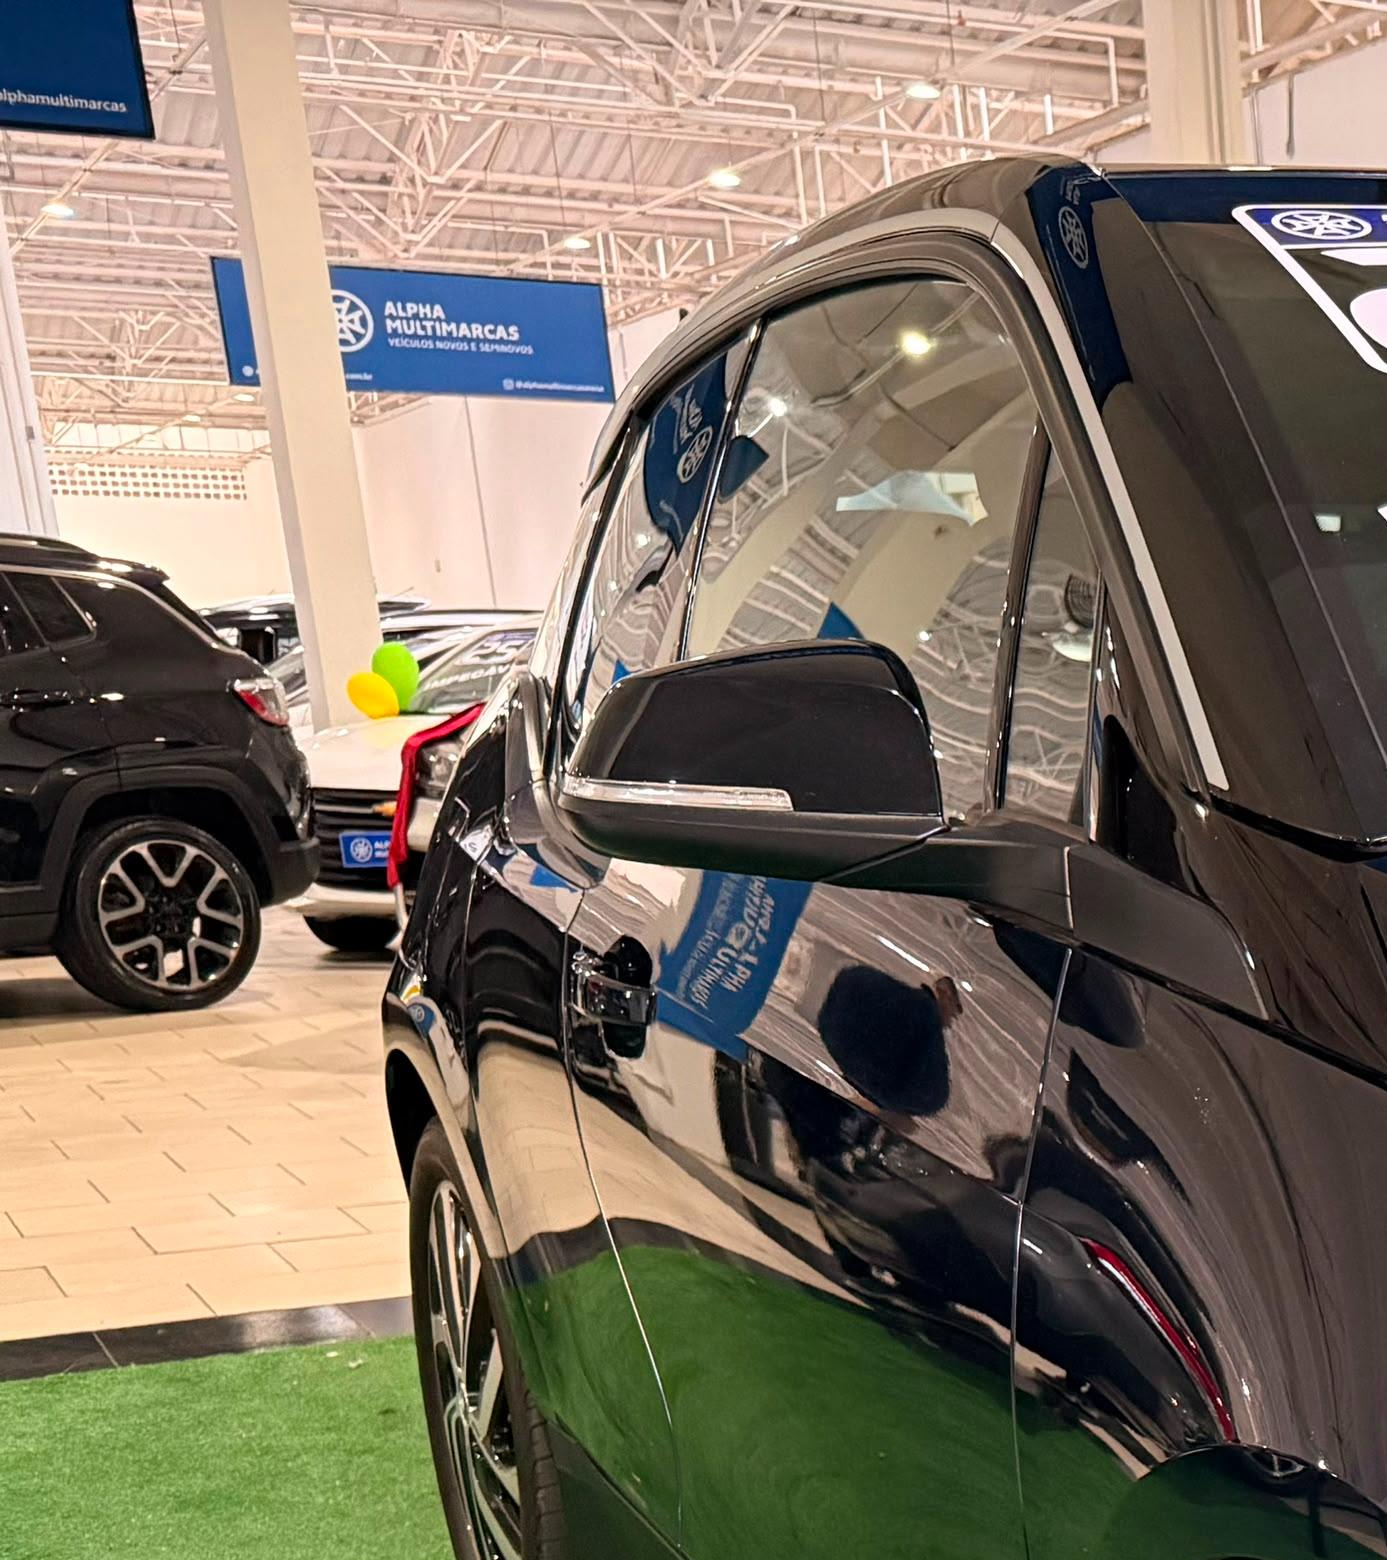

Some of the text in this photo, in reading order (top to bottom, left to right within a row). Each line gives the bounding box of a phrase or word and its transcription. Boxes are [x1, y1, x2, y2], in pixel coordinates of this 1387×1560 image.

[384, 300, 446, 320] ALPHA
[386, 318, 520, 341] MULTIMARCAS
[435, 340, 469, 352] NOVOS
[470, 342, 477, 353] E
